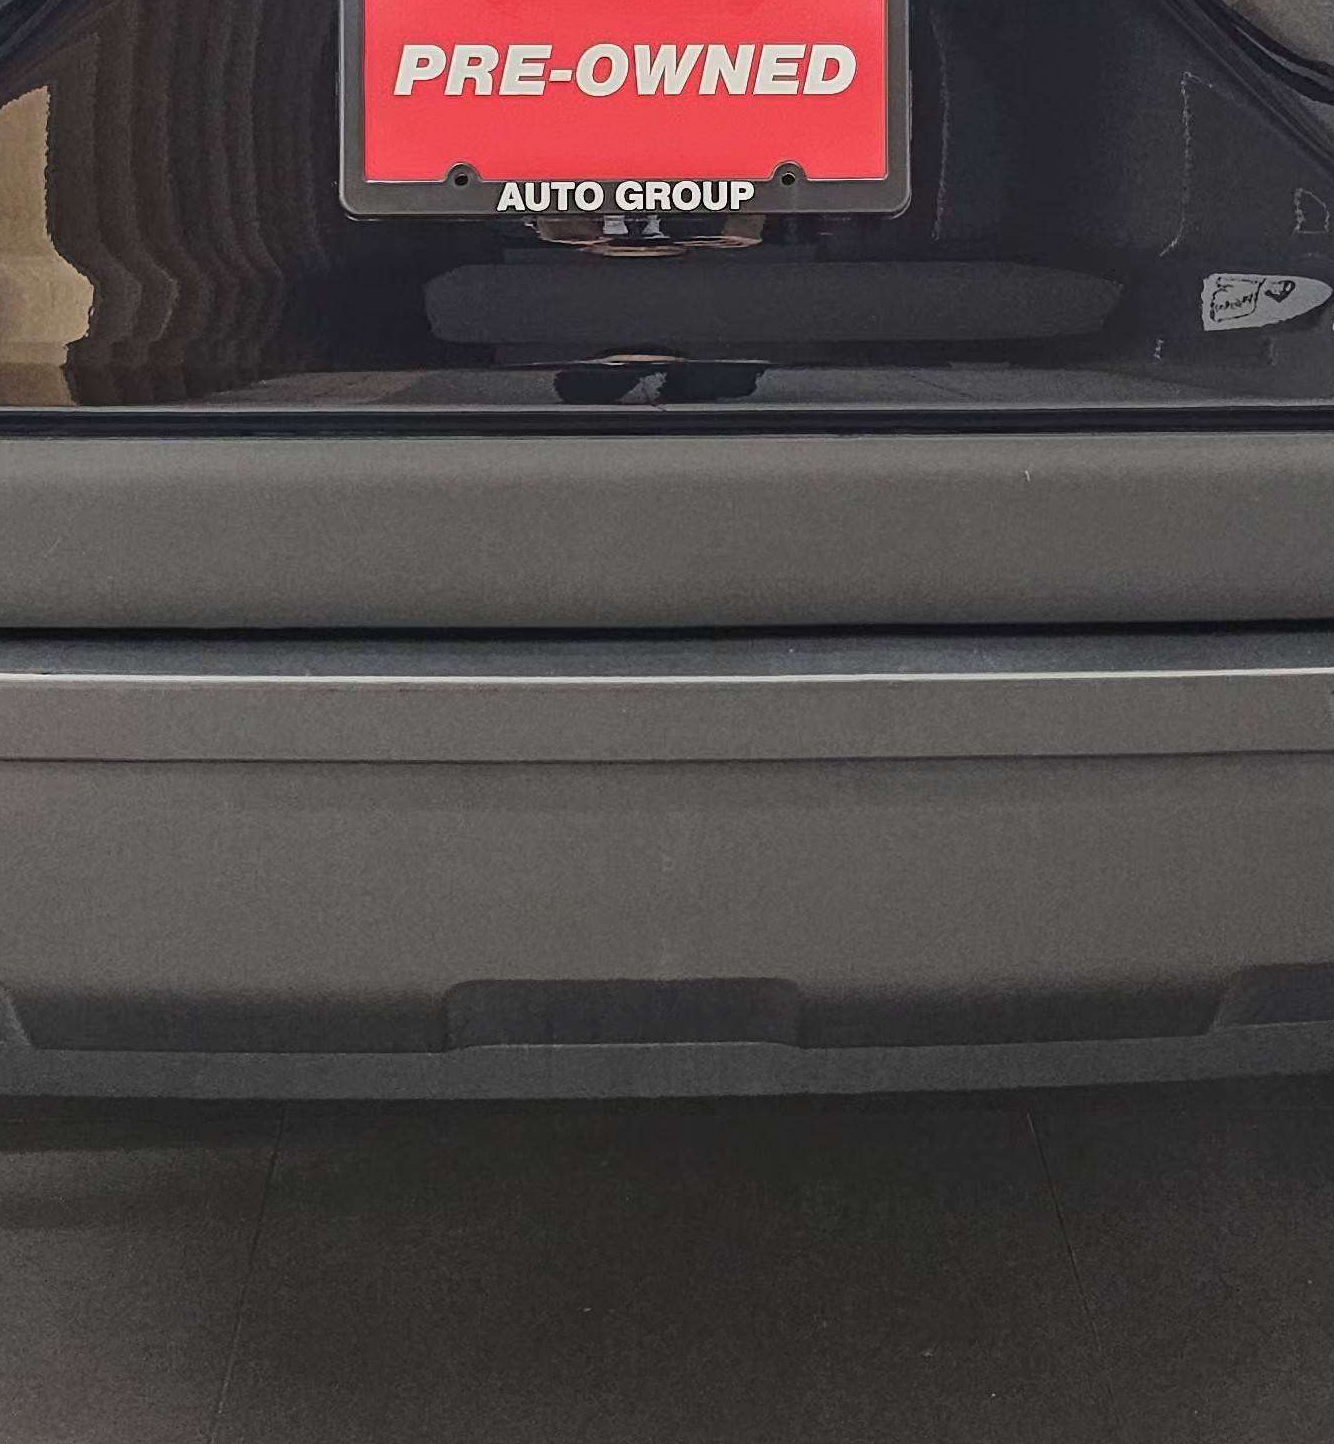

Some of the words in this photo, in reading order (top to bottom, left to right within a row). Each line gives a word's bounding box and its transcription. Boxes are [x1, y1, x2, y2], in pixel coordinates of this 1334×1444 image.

[394, 43, 858, 97] PRE-OWNED
[496, 180, 605, 212] AUTO
[615, 180, 755, 211] GROUP
